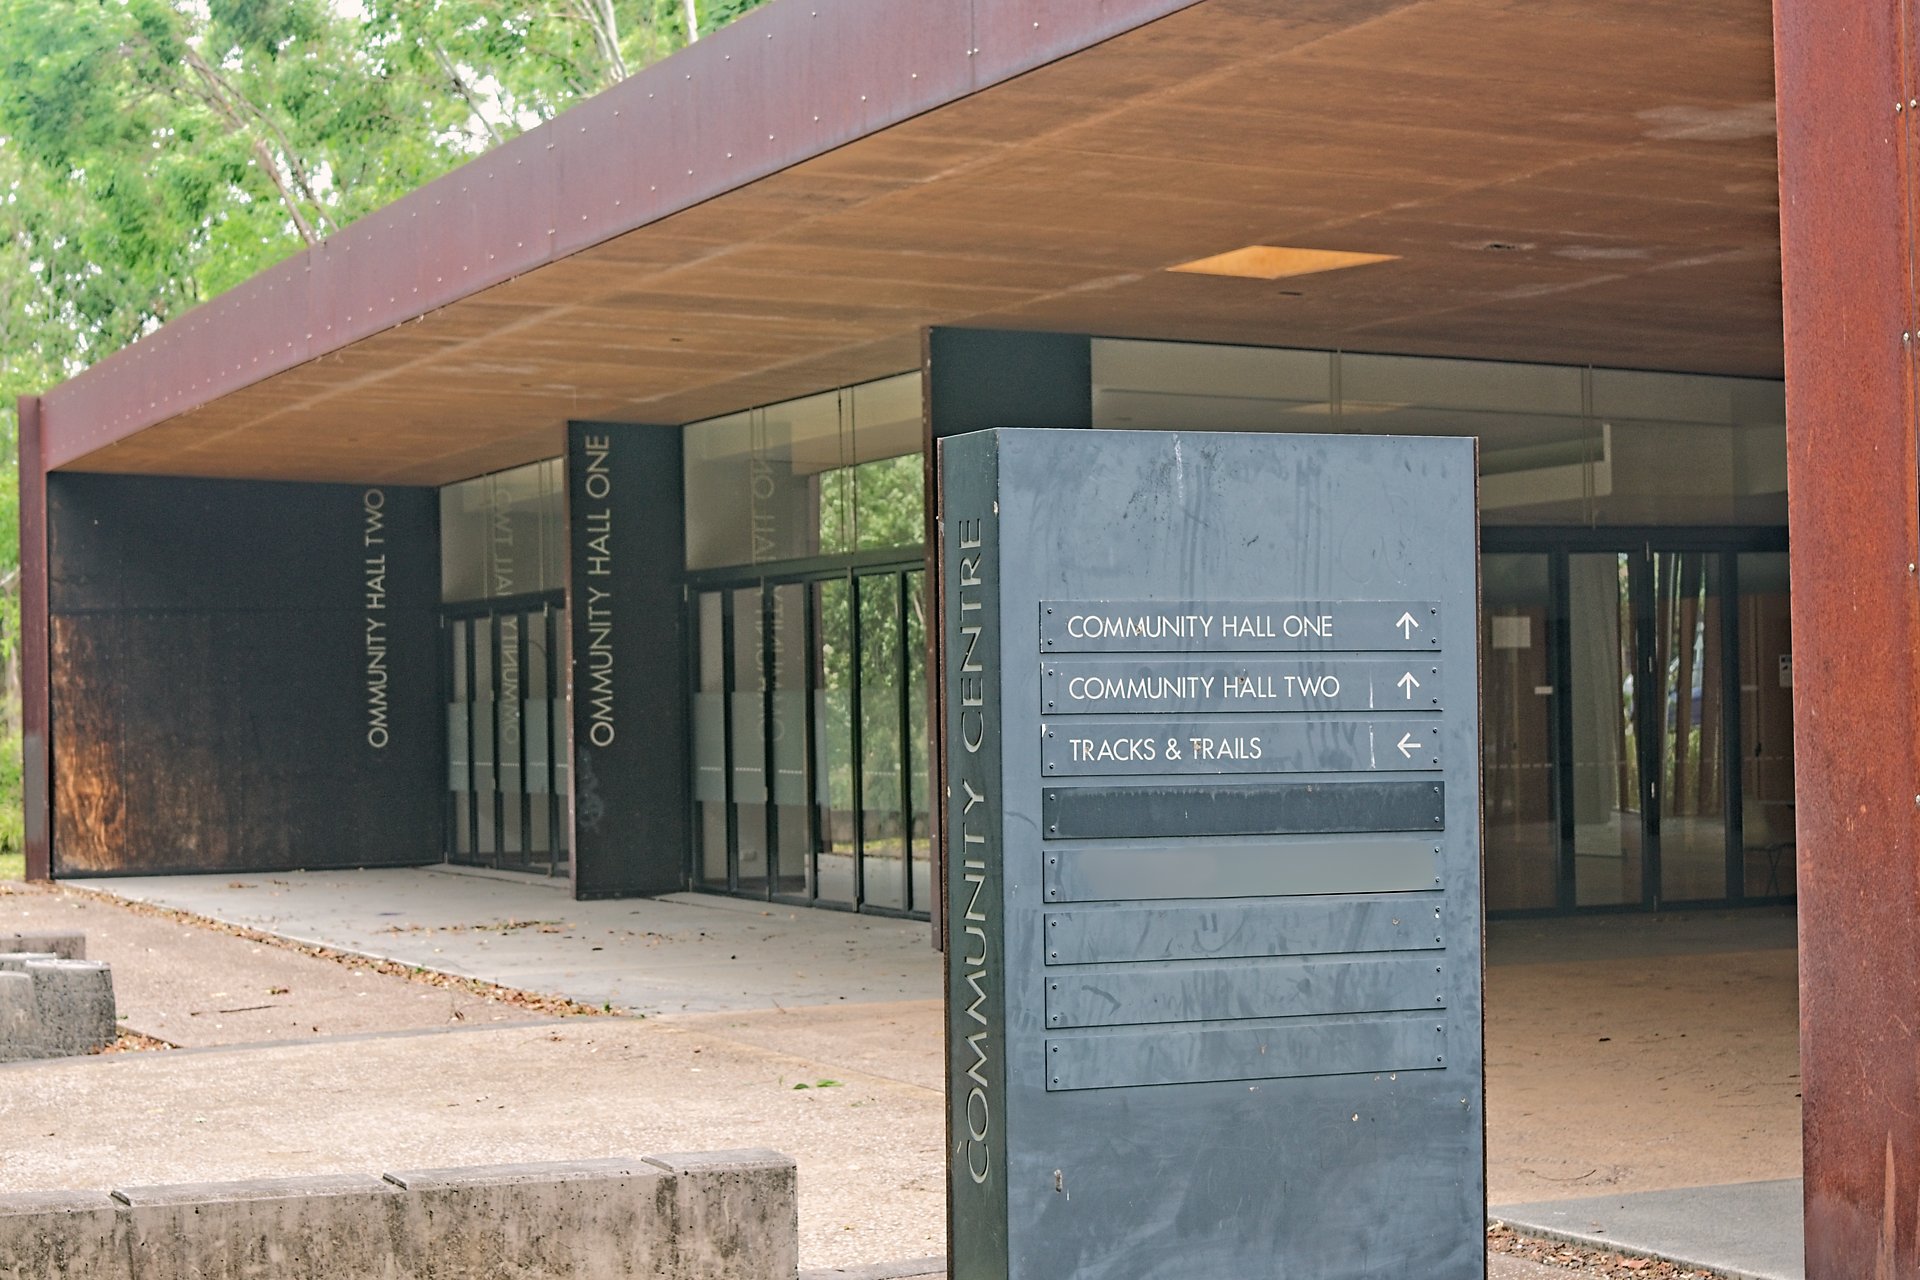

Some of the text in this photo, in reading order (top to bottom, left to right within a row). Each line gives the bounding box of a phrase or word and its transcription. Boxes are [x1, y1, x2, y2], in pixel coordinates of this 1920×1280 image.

[364, 489, 389, 748] OMMUNITY HALL TWO
[585, 435, 615, 747] OMMUNITY HALL ONE
[1067, 615, 1333, 638] COMMUNITY HALL ONE
[1068, 675, 1340, 700] COMMUNITY HALL TWO
[1069, 737, 1262, 761] TRACKS & TRAILS
[959, 518, 989, 1184] COMMUNITY CENTRE
